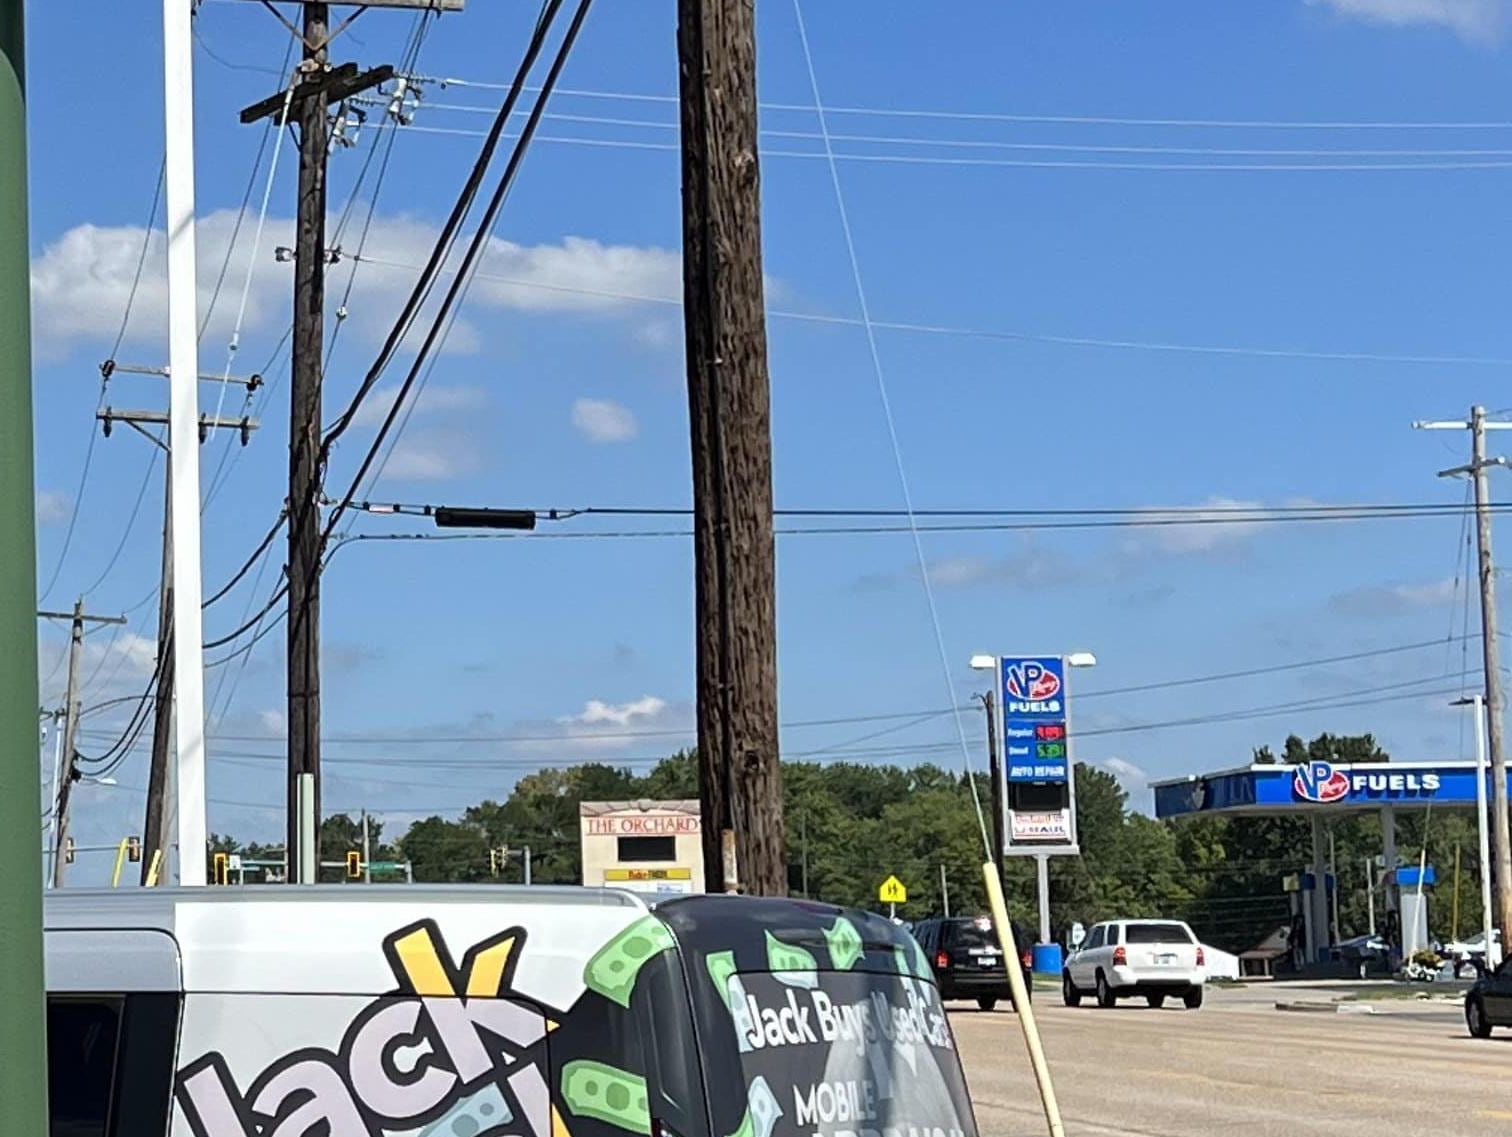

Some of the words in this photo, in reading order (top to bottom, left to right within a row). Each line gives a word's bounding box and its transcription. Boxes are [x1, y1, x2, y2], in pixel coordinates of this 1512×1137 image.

[1009, 701, 1061, 712] FUELS
[1352, 774, 1440, 791] FUELS
[588, 819, 614, 833] THE
[620, 817, 698, 833] ORCHARD
[748, 989, 818, 1049] Jack
[813, 987, 876, 1058] Buys
[793, 1080, 877, 1126] MOBILE
